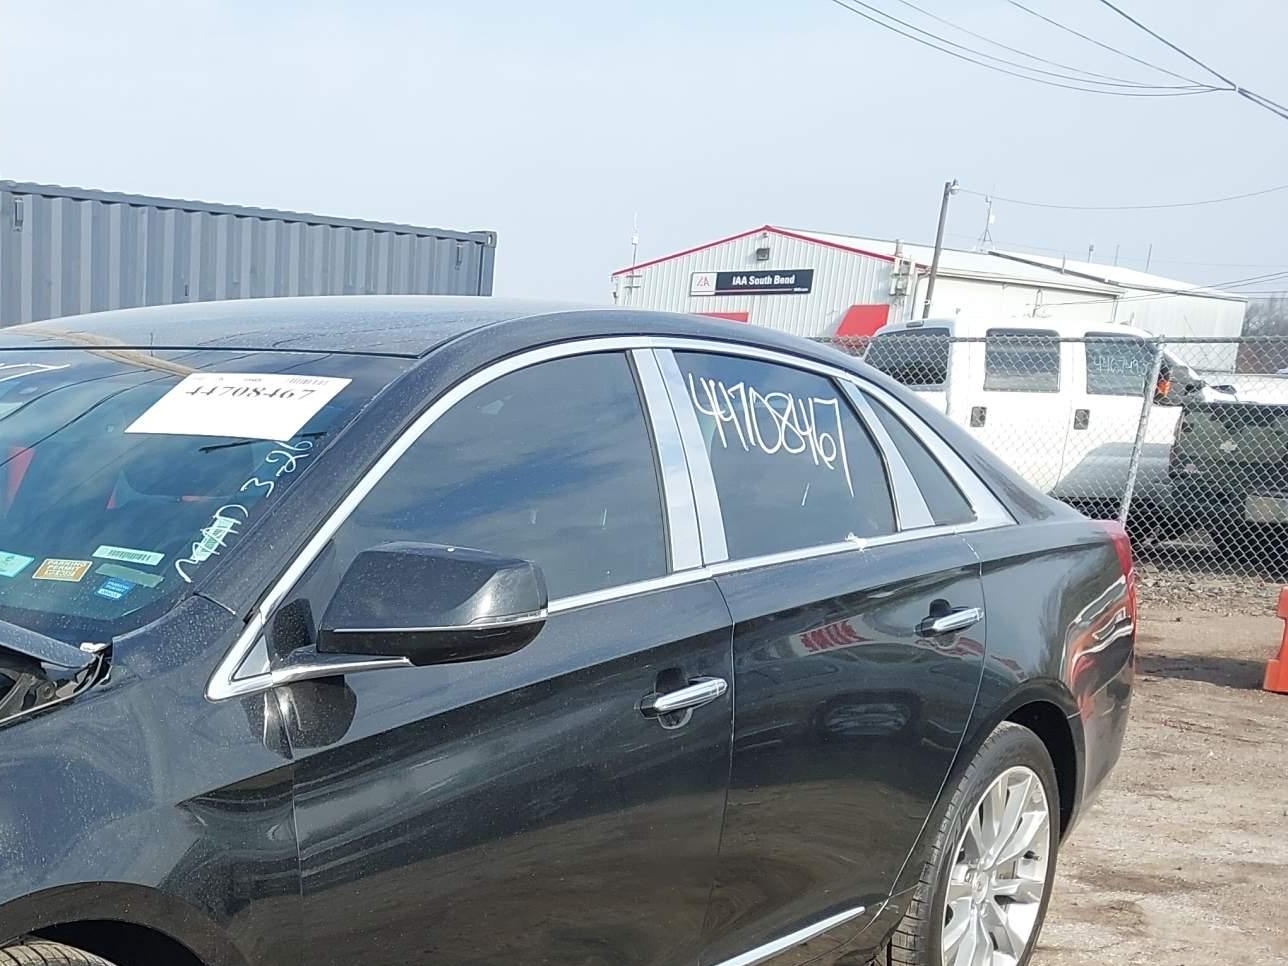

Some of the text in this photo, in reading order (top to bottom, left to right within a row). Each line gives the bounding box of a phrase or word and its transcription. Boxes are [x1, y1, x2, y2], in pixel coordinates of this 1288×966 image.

[732, 274, 796, 286] IAA South Bend
[185, 385, 316, 400] 44708467
[688, 372, 854, 499] 44708467
